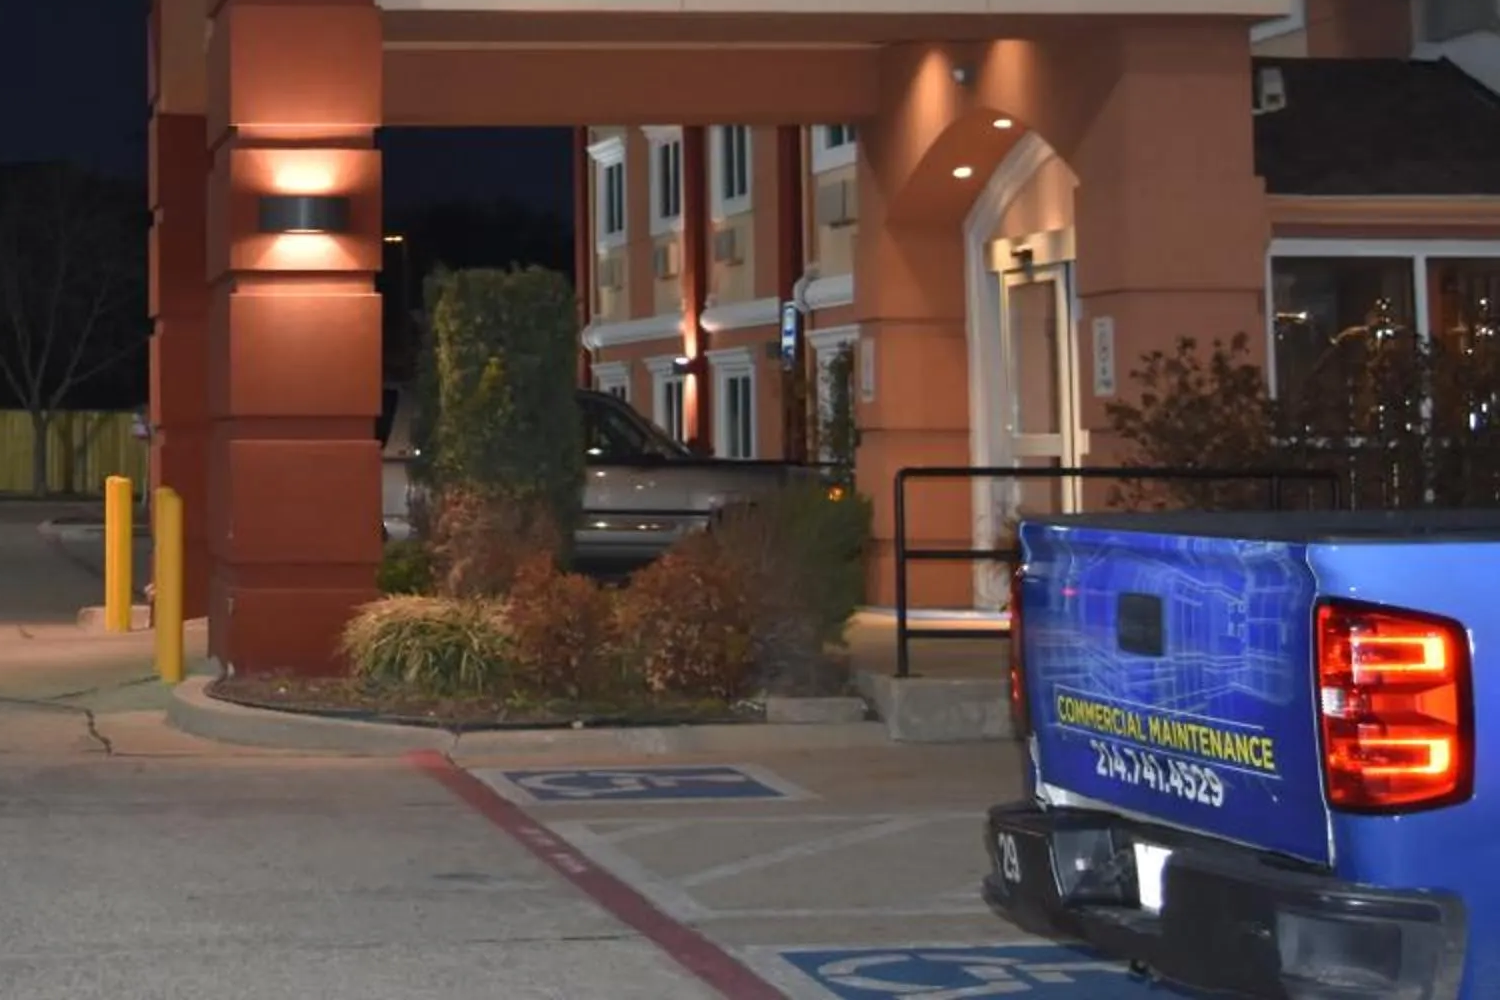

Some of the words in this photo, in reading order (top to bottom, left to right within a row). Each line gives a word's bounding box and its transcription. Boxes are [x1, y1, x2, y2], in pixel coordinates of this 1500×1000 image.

[1056, 695, 1147, 742] COMMERCIAL
[1148, 715, 1276, 771] MAINTENANCE
[1089, 738, 1224, 808] 214.741.4529
[998, 831, 1021, 883] 29
